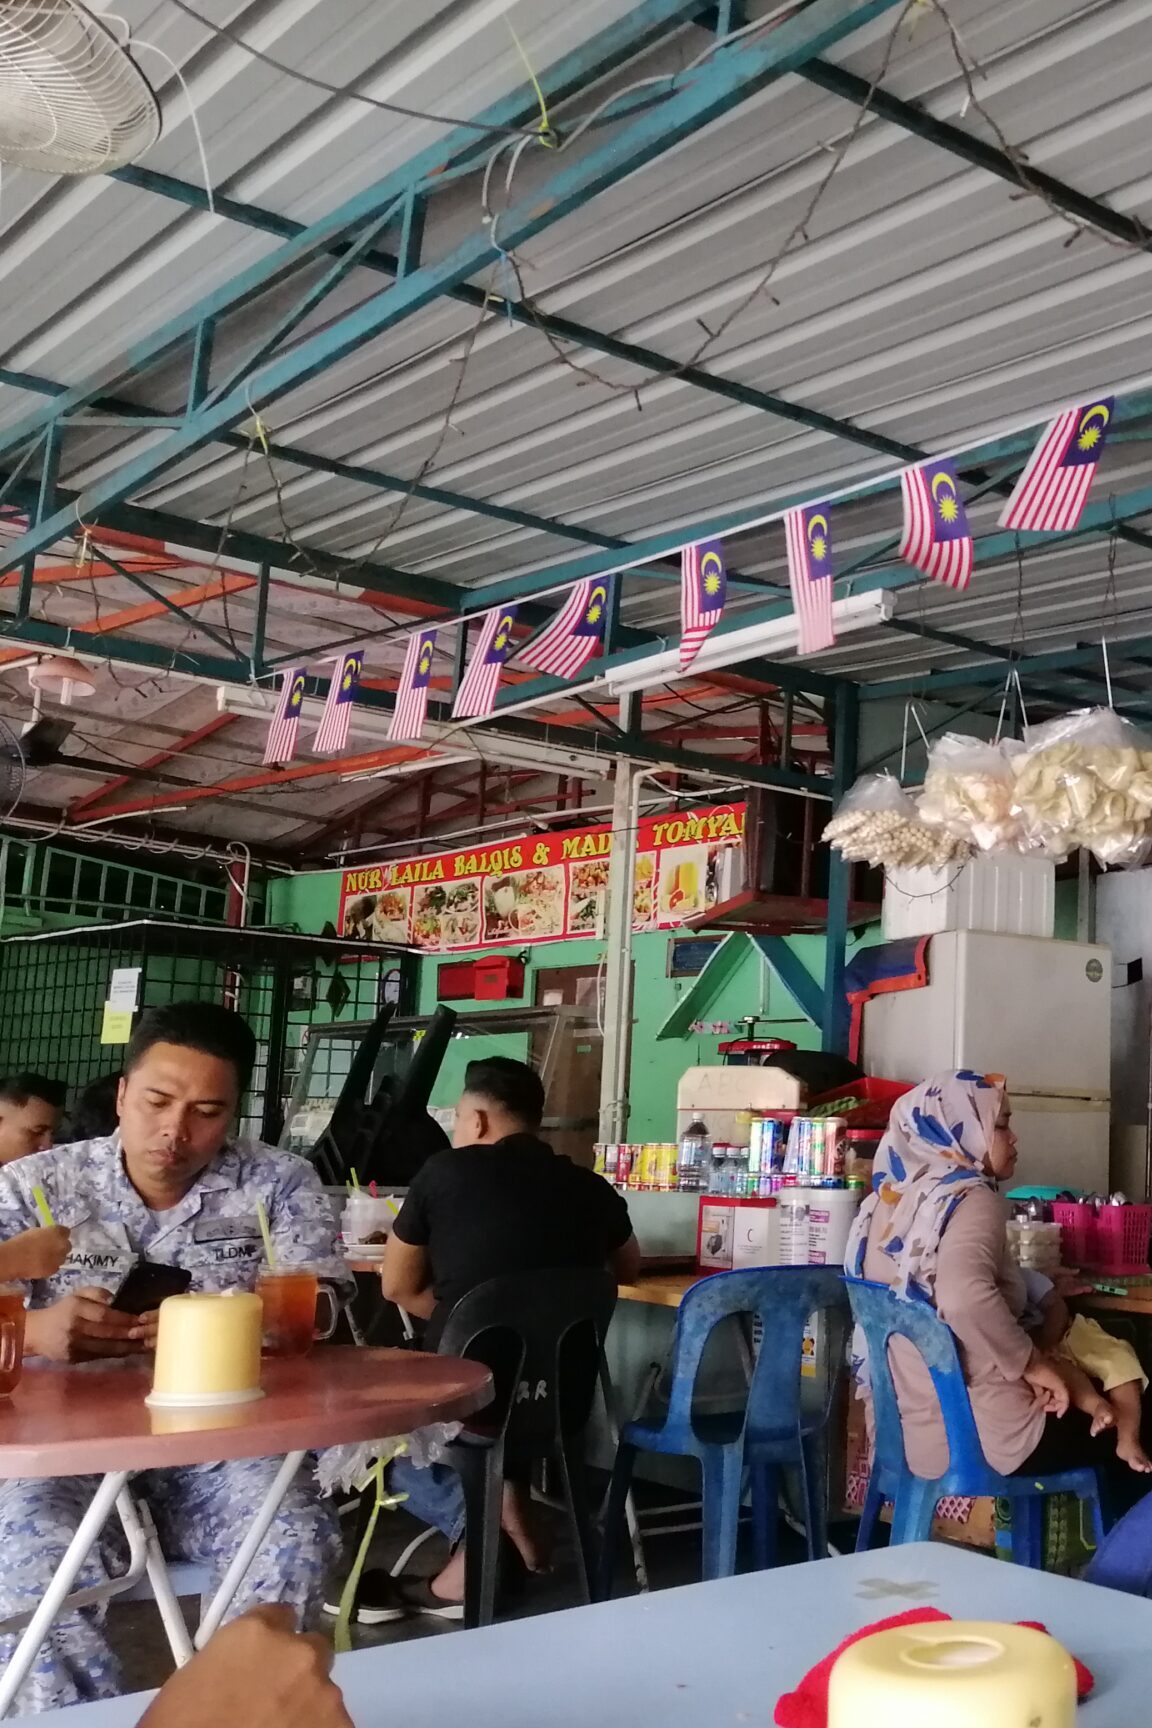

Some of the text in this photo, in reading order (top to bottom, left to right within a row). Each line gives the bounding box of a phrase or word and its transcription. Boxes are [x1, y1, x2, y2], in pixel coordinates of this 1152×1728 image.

[345, 868, 382, 892] NUR
[391, 859, 444, 886] LAILA
[454, 846, 523, 878] BALQIS
[532, 842, 550, 866] &
[652, 813, 746, 847] TOMYA
